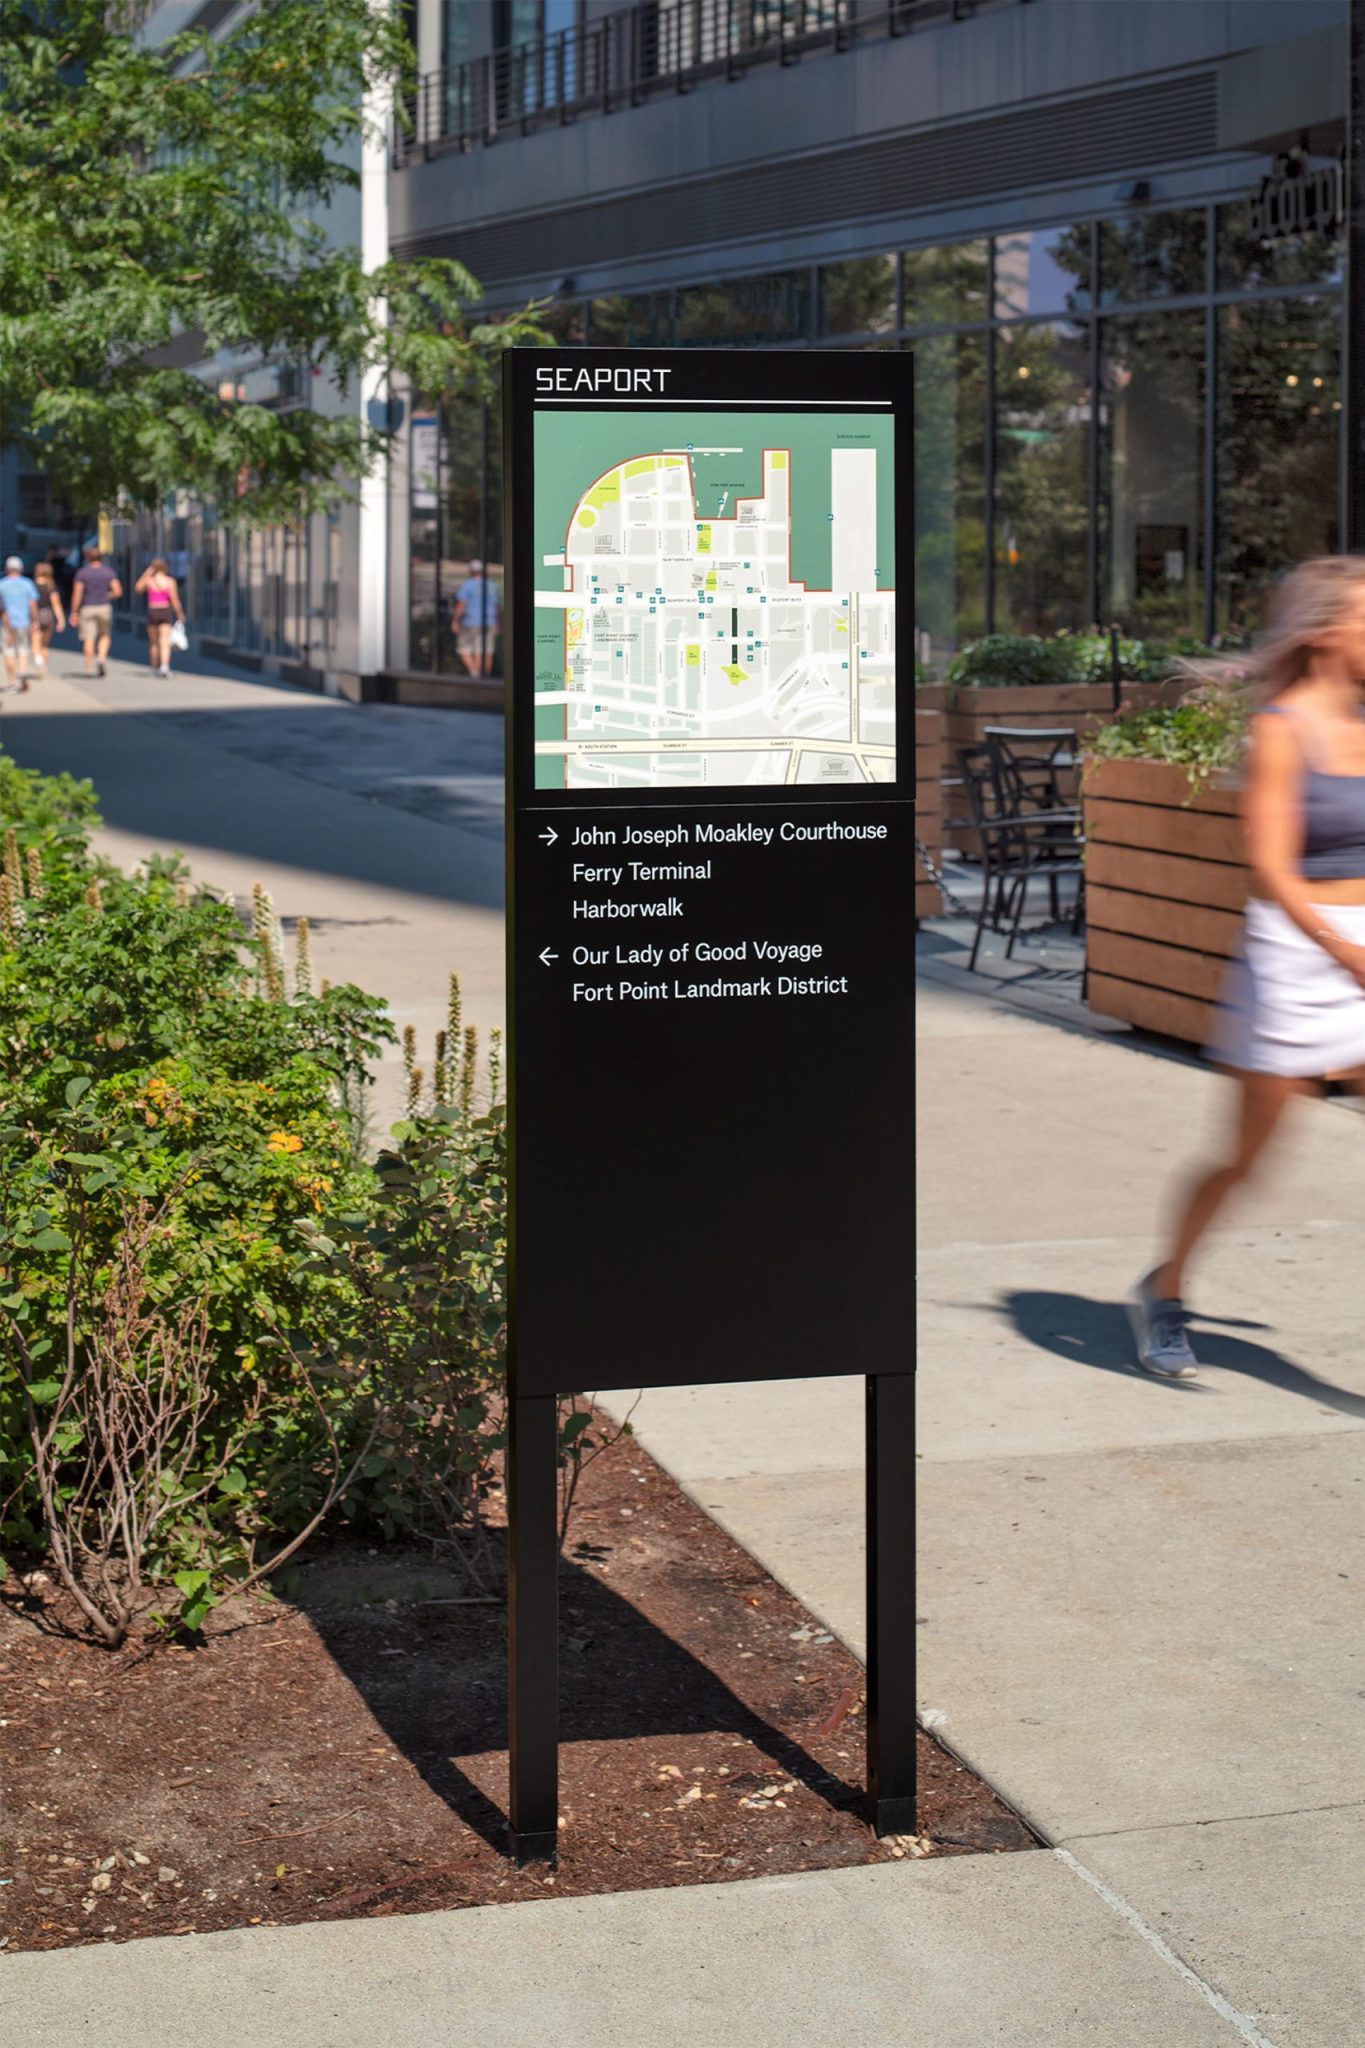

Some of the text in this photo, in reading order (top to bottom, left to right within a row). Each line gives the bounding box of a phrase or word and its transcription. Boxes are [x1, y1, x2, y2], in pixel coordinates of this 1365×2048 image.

[536, 368, 672, 392] SEAPORT
[571, 820, 888, 848] John Joseph Moakley Courthouse
[573, 860, 712, 886] Ferry Terminal
[573, 896, 684, 919] Harborwalk
[572, 940, 823, 967] Our Lady of Good Voyage
[573, 974, 849, 1002] Fort Point Landmark District
